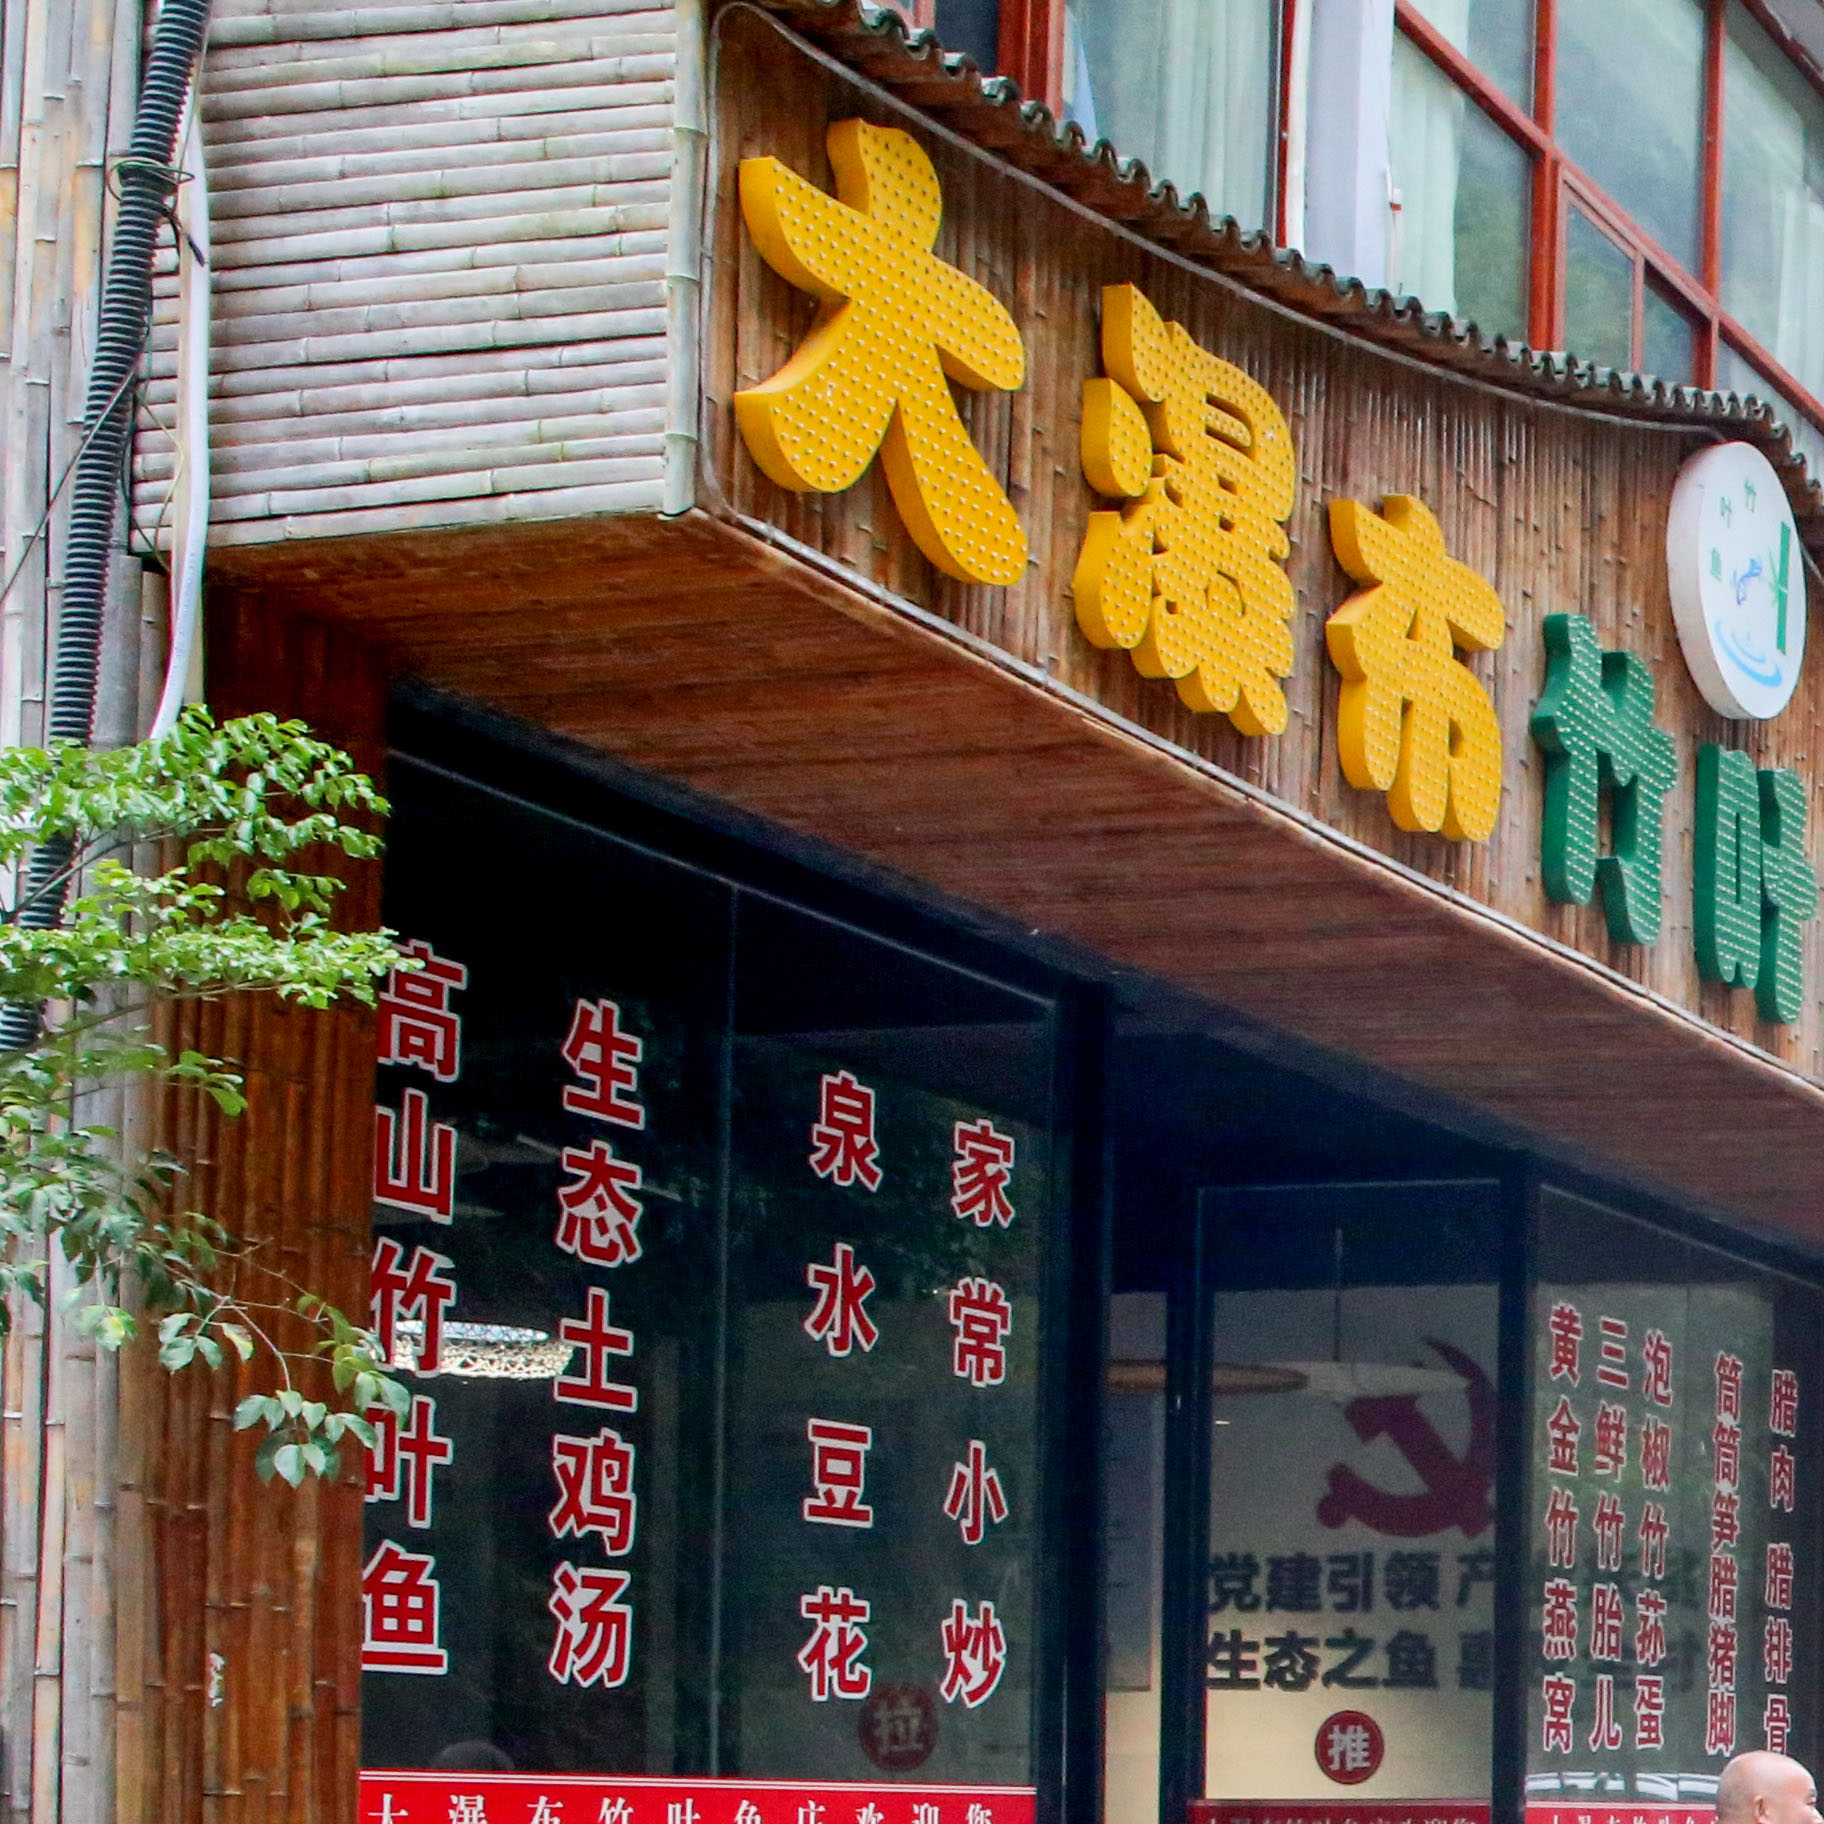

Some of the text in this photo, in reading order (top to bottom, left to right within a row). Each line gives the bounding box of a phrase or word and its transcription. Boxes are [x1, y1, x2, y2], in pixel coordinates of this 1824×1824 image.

[362, 940, 470, 1675] 高山竹叶鱼
[549, 999, 646, 1687] 生态土鸡汤
[798, 1070, 883, 1702] 泉水豆花
[941, 1119, 1016, 1708] 家常小炒
[1542, 1301, 1583, 1754] 黄金竹燕窝
[1206, 1551, 1441, 1613] 党建引领
[1206, 1628, 1440, 1691] 生态之鱼
[1326, 1723, 1371, 1772] 推
